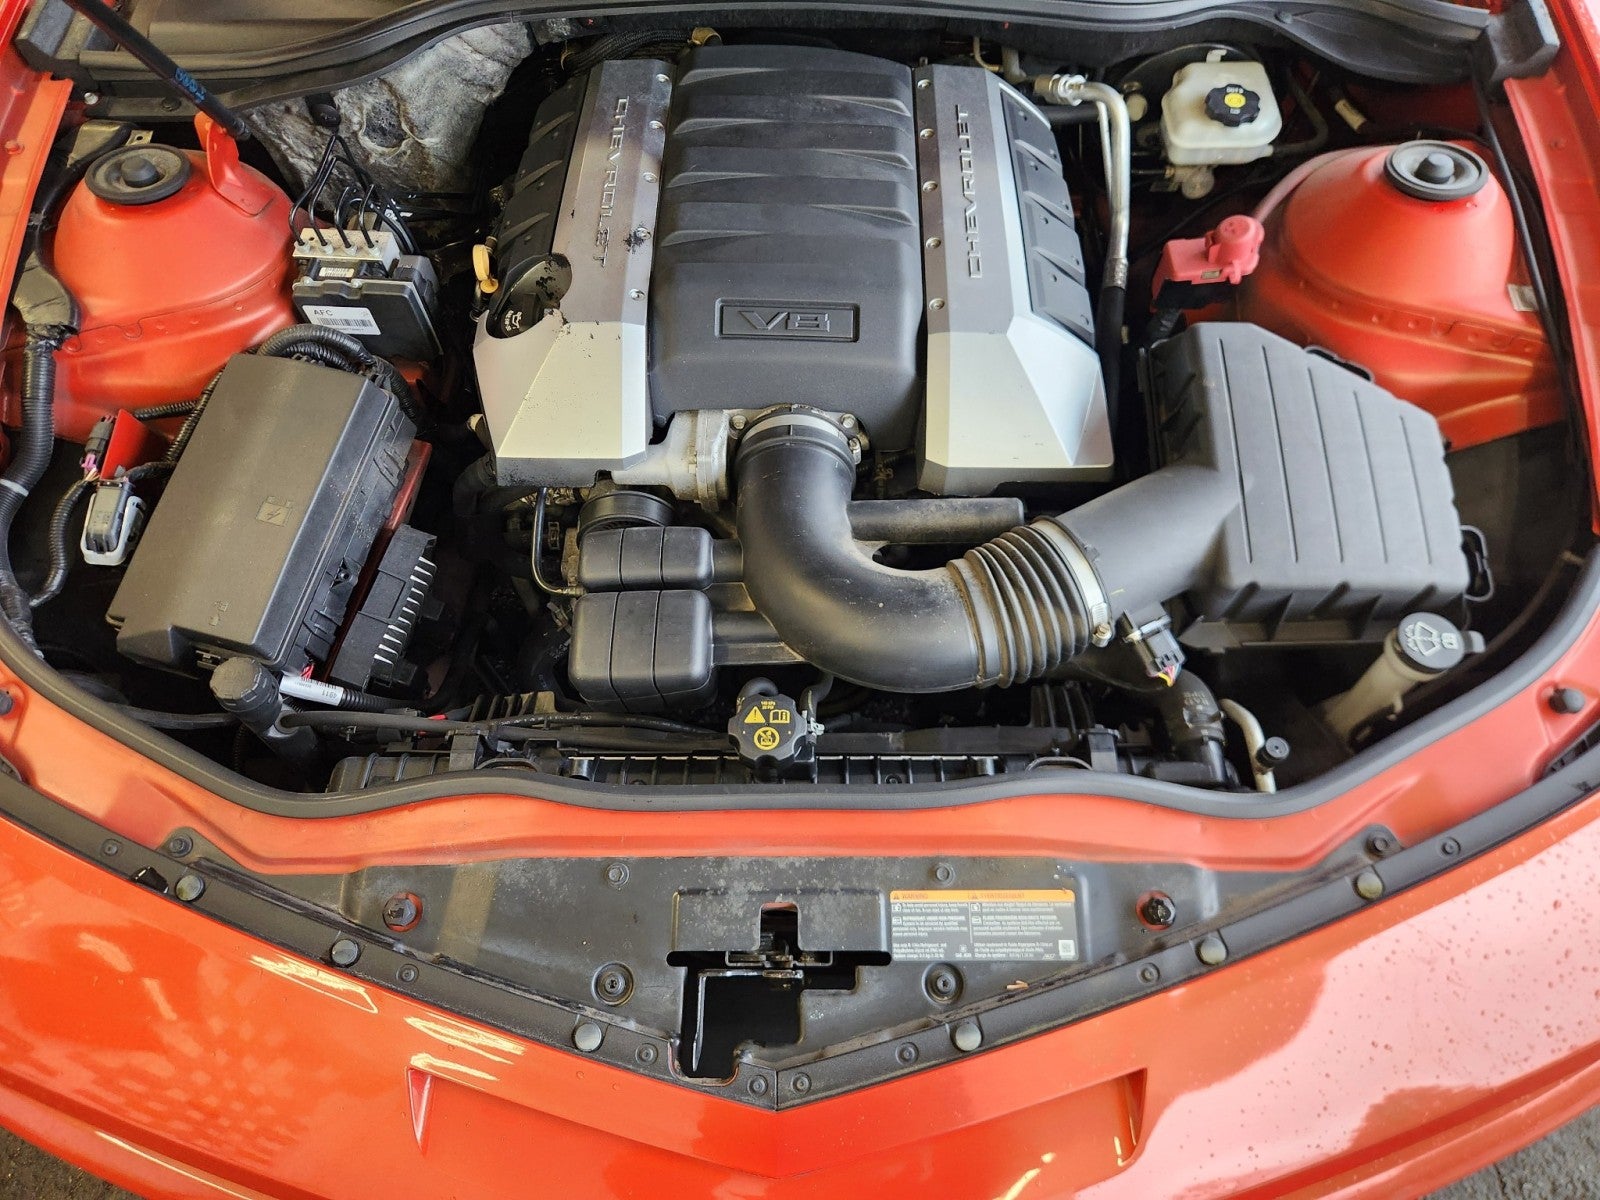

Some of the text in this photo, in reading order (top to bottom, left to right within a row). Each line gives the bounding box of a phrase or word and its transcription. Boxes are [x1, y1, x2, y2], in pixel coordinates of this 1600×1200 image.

[593, 96, 629, 267] CHEVROLET
[955, 104, 982, 278] CHEVROLET
[738, 310, 830, 333] V8
